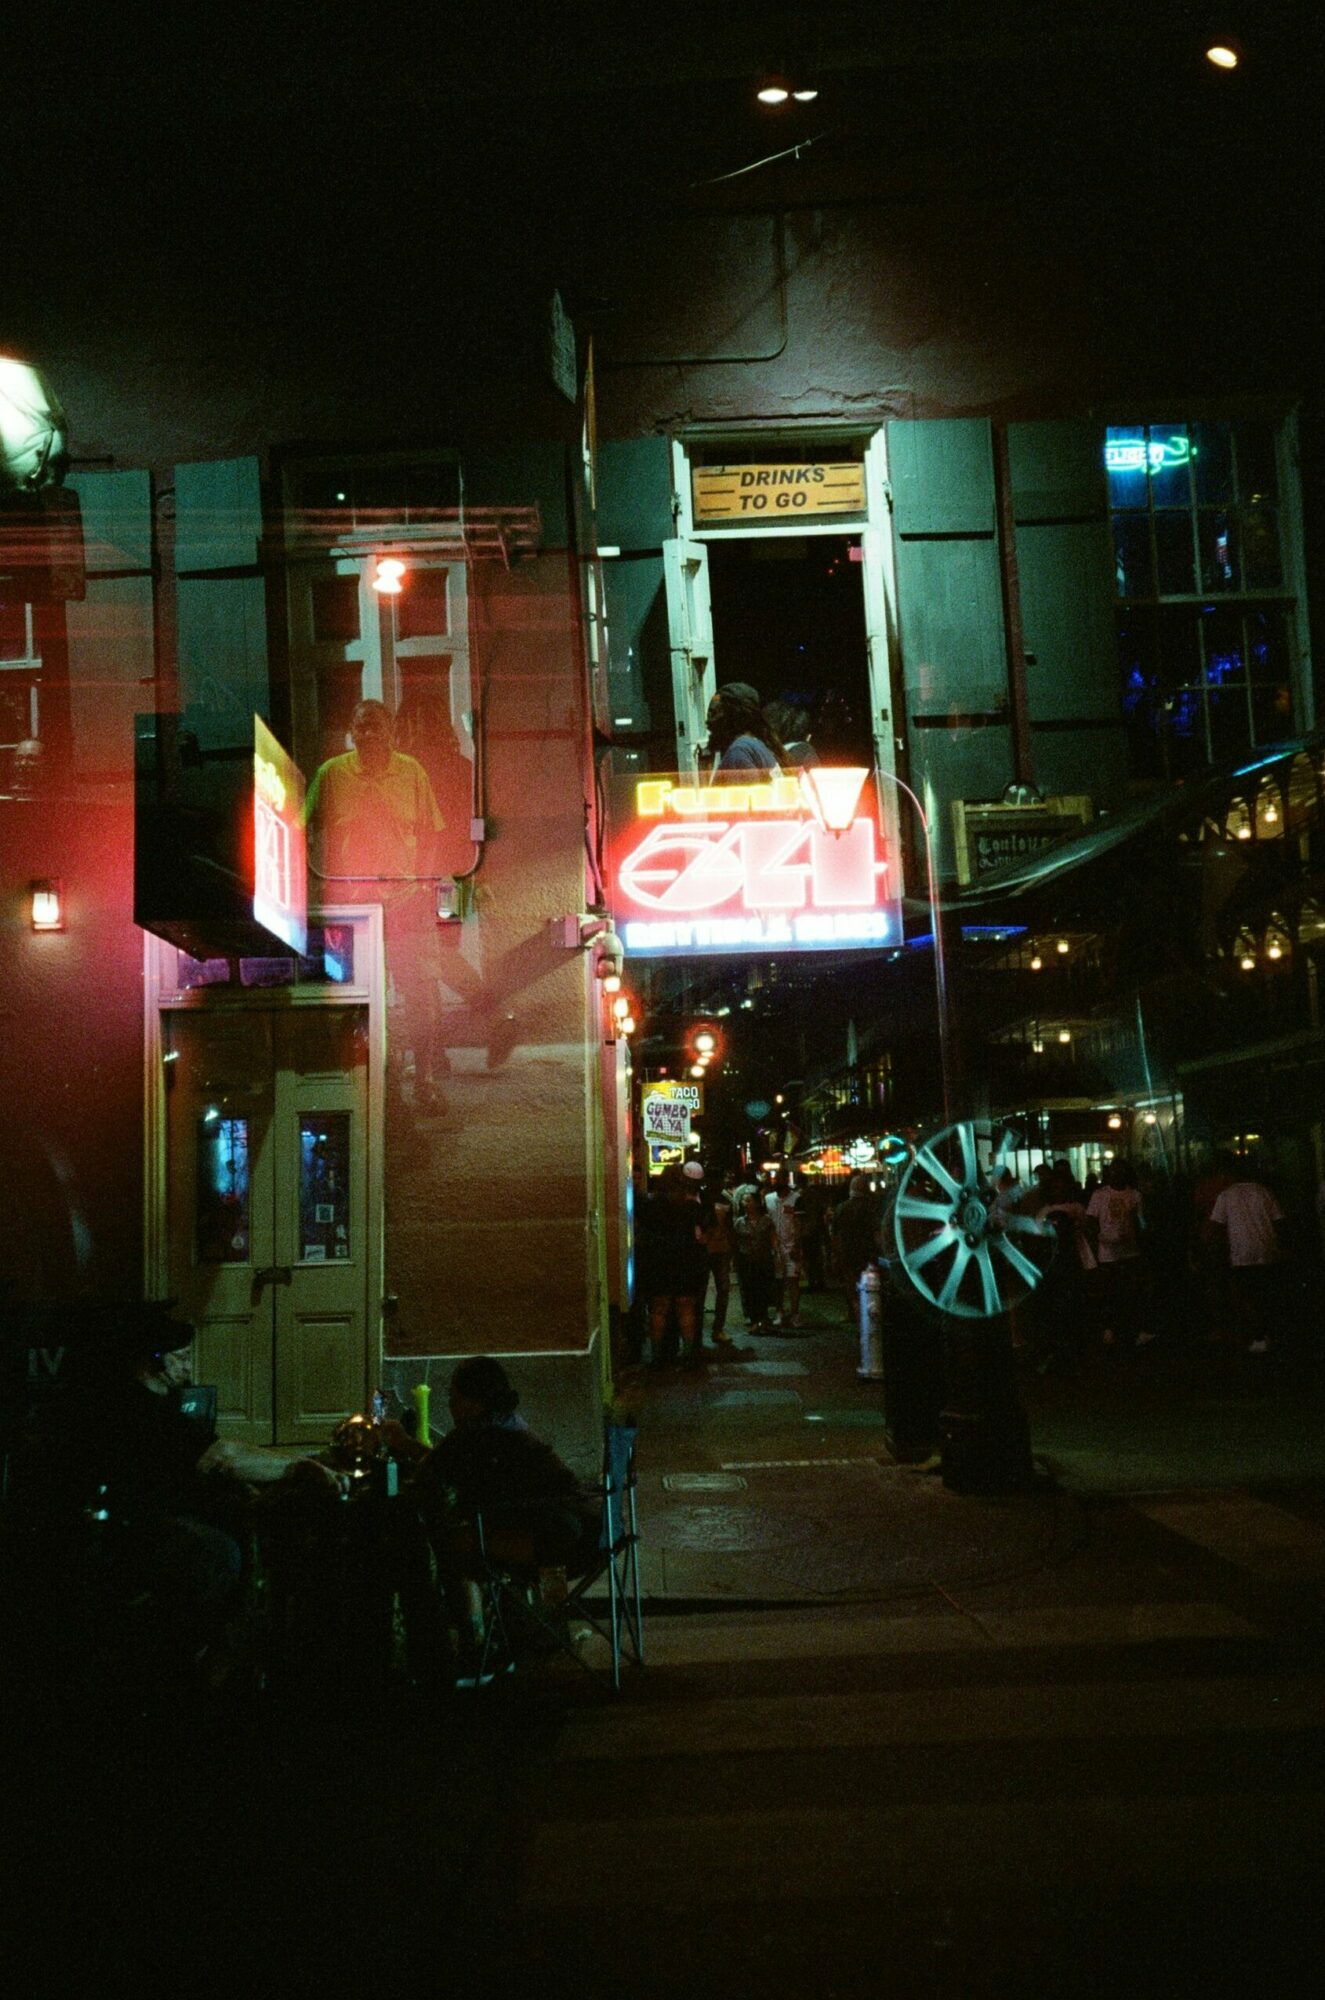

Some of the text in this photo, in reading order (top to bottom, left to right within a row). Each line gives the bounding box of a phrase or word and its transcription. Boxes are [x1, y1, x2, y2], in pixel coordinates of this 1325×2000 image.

[740, 467, 825, 487] DRINKS
[739, 491, 808, 511] TO GO
[670, 1087, 699, 1099] TACO
[646, 1102, 688, 1118] GUMBO
[649, 1116, 682, 1132] YA YA
